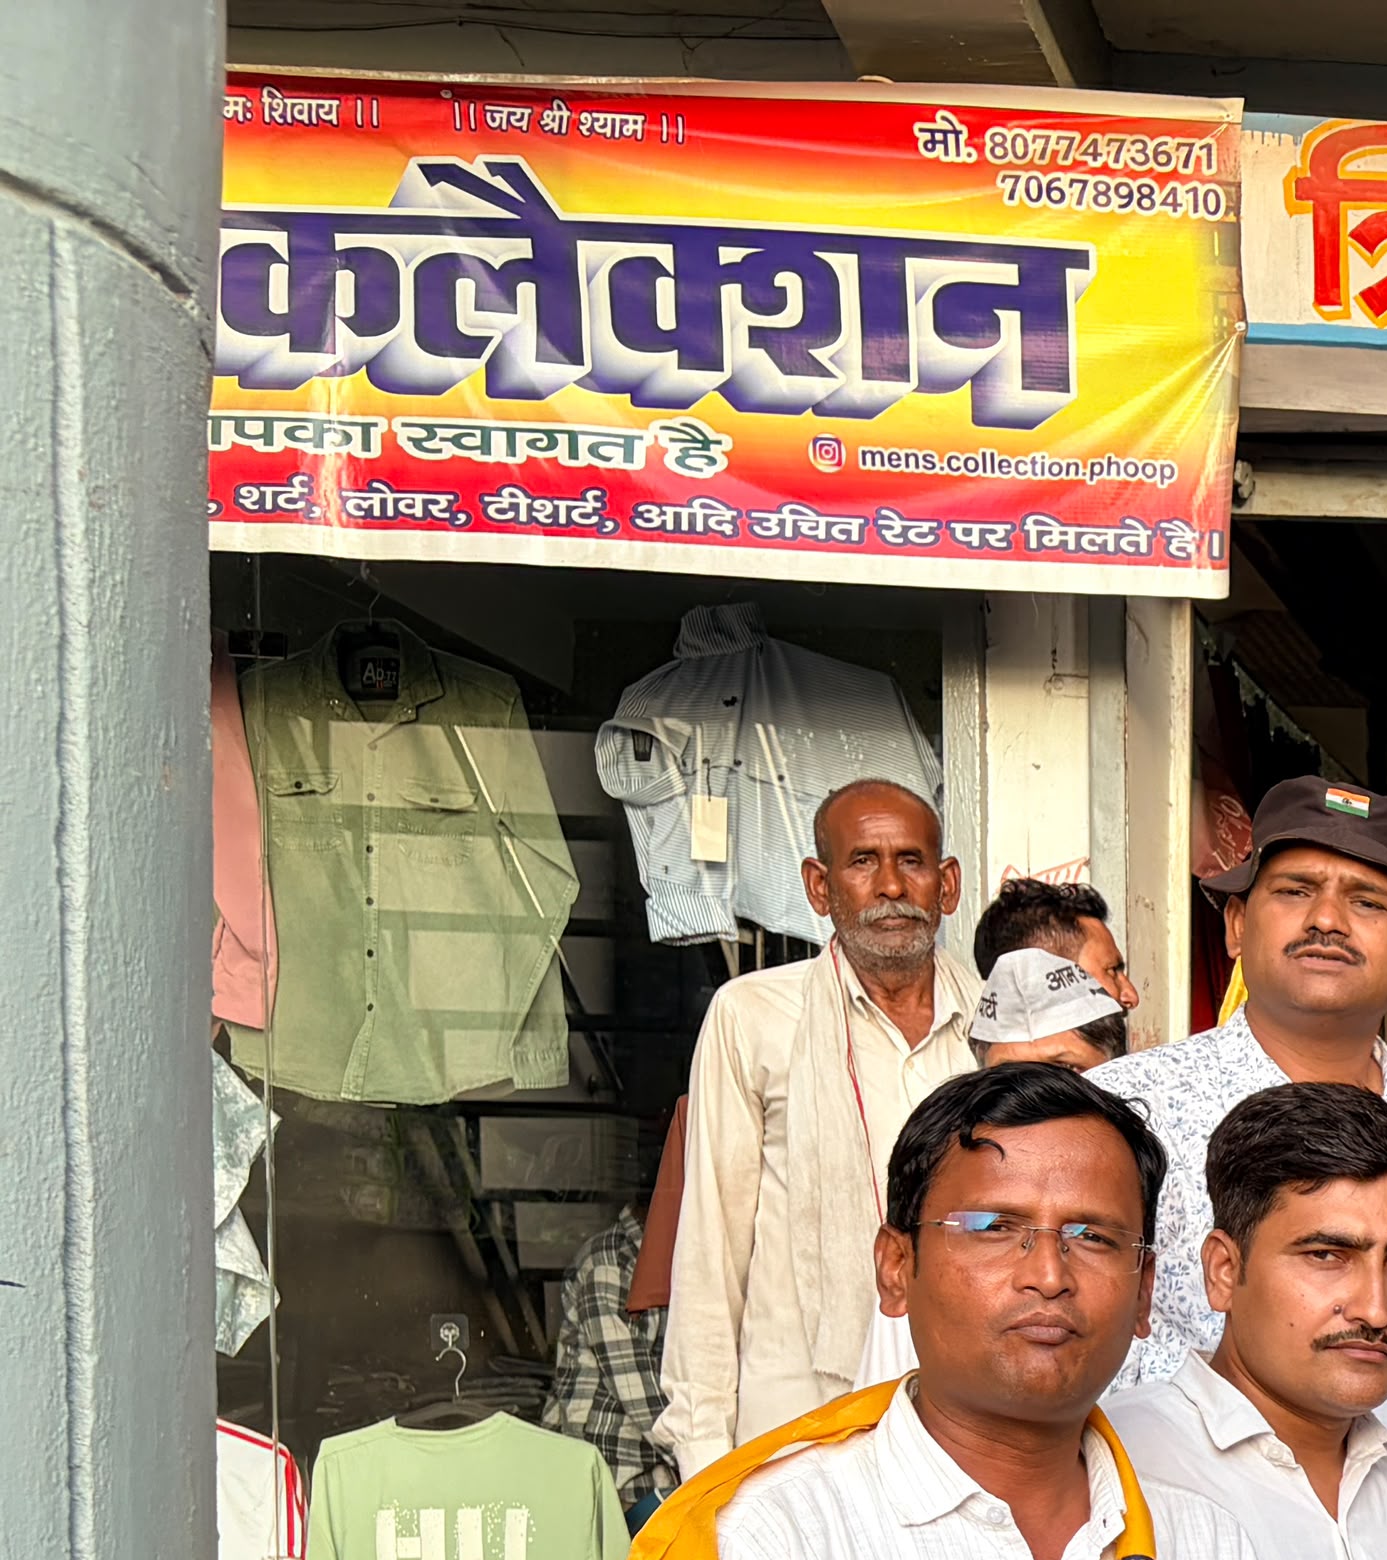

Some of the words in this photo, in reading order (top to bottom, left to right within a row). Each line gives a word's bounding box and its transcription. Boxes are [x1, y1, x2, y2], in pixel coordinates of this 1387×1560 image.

[263, 88, 339, 126] शिवाय
[485, 104, 530, 131] जय
[539, 100, 570, 134] श्री
[579, 112, 644, 140] श्याम
[988, 131, 1213, 171] 8077473671
[1001, 174, 1221, 215] 7067898410
[402, 423, 642, 463] स्वागत
[660, 420, 724, 473] है
[860, 447, 1175, 486] mens.collection.phoop
[634, 496, 738, 532] आदि
[754, 505, 861, 541] उचित
[880, 508, 936, 544] रेट
[953, 522, 1009, 549] पर
[1028, 516, 1151, 554] मिलते
